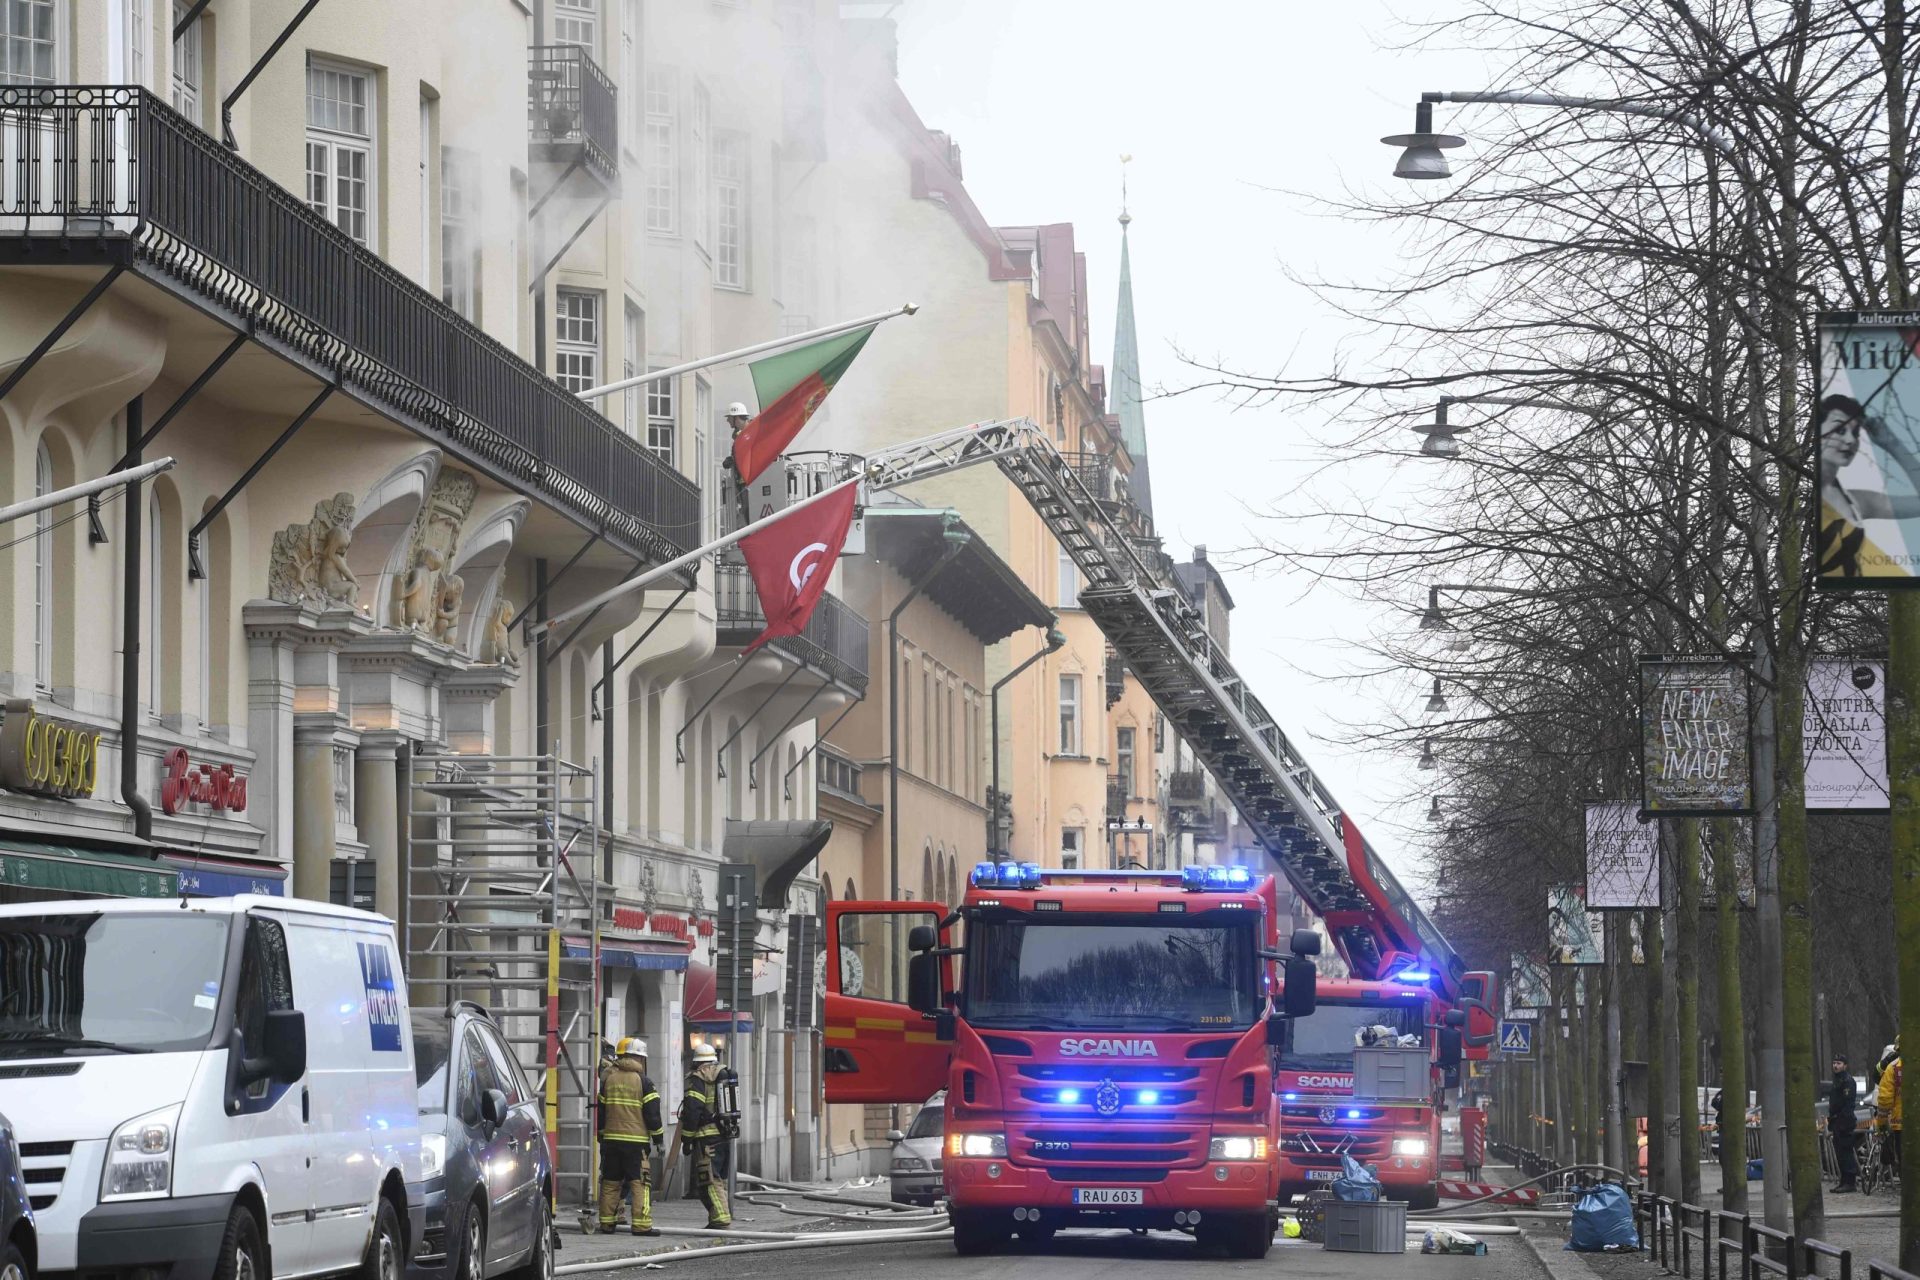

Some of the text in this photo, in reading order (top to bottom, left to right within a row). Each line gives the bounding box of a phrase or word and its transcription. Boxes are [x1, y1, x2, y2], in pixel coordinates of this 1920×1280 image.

[1660, 690, 1716, 719] NEW
[1829, 717, 1872, 732] ALLA
[1661, 720, 1734, 749] ENTER
[1803, 733, 1863, 751] TRÖTTA
[1662, 749, 1732, 779] IMAGE
[1059, 1038, 1158, 1057] SCANIA
[1034, 1142, 1070, 1150] P 370
[1312, 1171, 1328, 1179] ENH
[1083, 1191, 1137, 1203] RAU 603
